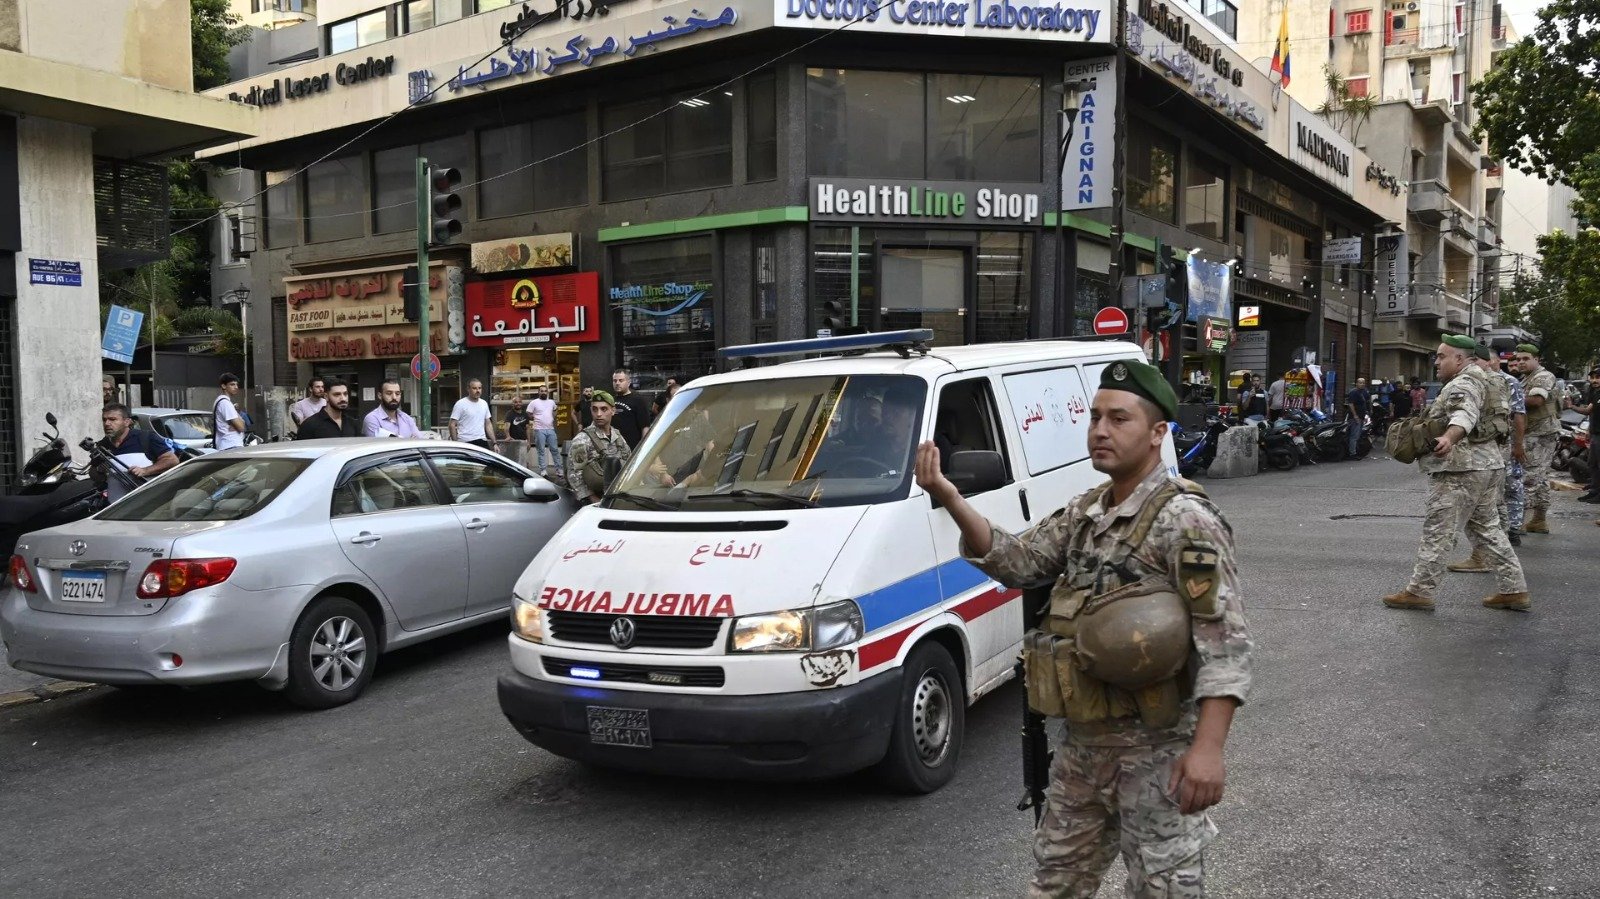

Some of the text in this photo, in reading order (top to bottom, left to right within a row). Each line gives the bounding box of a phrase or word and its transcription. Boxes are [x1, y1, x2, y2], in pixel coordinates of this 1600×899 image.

[623, 6, 738, 57] مختبر
[786, 0, 881, 23] Doctors
[887, 0, 969, 28] Center
[973, 0, 1100, 40] Laboratory
[448, 45, 540, 93] الأطباء
[543, 34, 620, 75] مركز
[1068, 61, 1110, 77] CENTER
[1183, 23, 1213, 65] Laser
[1213, 48, 1244, 87] Cener
[285, 72, 330, 100] Laser
[335, 55, 395, 86] Center
[1297, 121, 1350, 178] MARIGNAN
[817, 183, 1039, 223] HealthLine Shop
[1388, 253, 1397, 310] WEEKEND
[290, 312, 309, 323] FAST
[310, 310, 330, 321] FOOD
[472, 305, 585, 339] الجامعة
[290, 329, 443, 360] Golden Sheep Restaurnt
[1021, 394, 1087, 435] الدفاع المدني
[562, 538, 763, 566] الدفاع المدني
[62, 581, 104, 599] G221474
